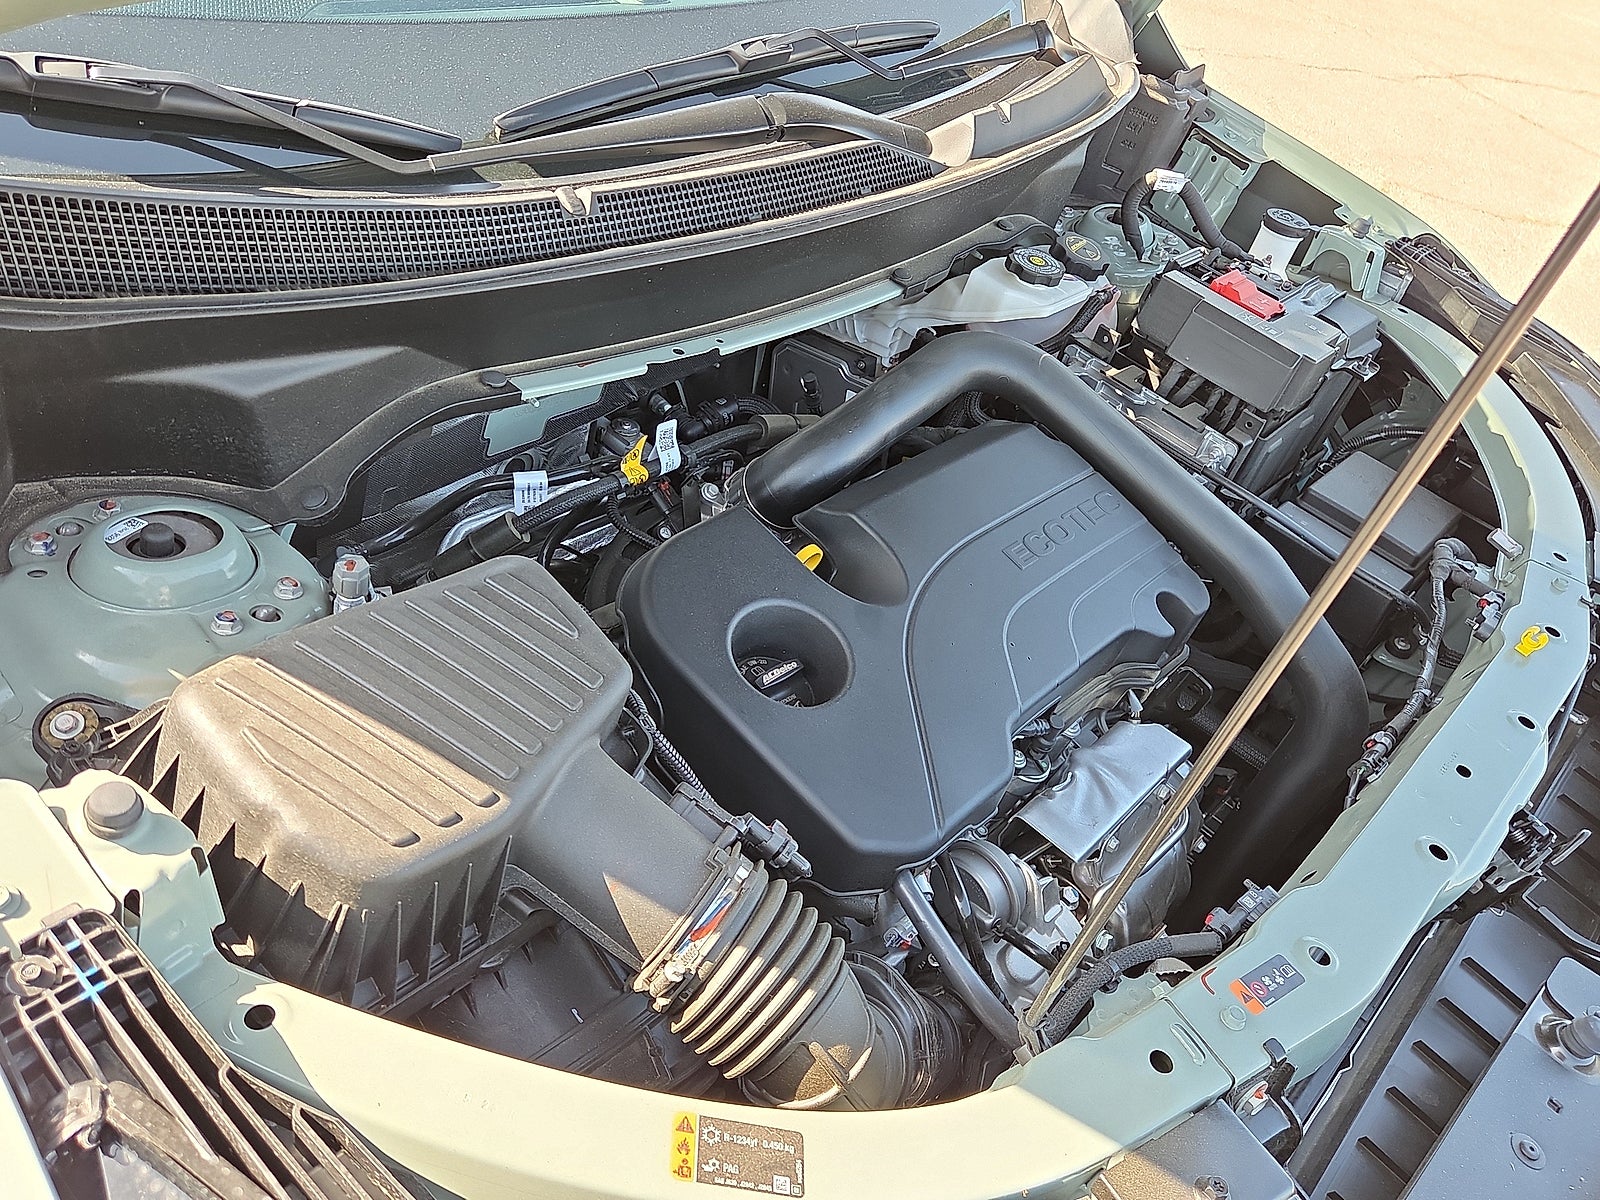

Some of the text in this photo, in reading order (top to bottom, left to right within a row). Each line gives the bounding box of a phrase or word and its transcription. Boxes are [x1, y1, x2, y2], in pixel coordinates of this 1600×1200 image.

[1002, 489, 1120, 571] ECOTEC
[762, 661, 798, 684] ACDelco
[723, 1133, 758, 1148] R-1234yf
[722, 1163, 739, 1174] PAG
